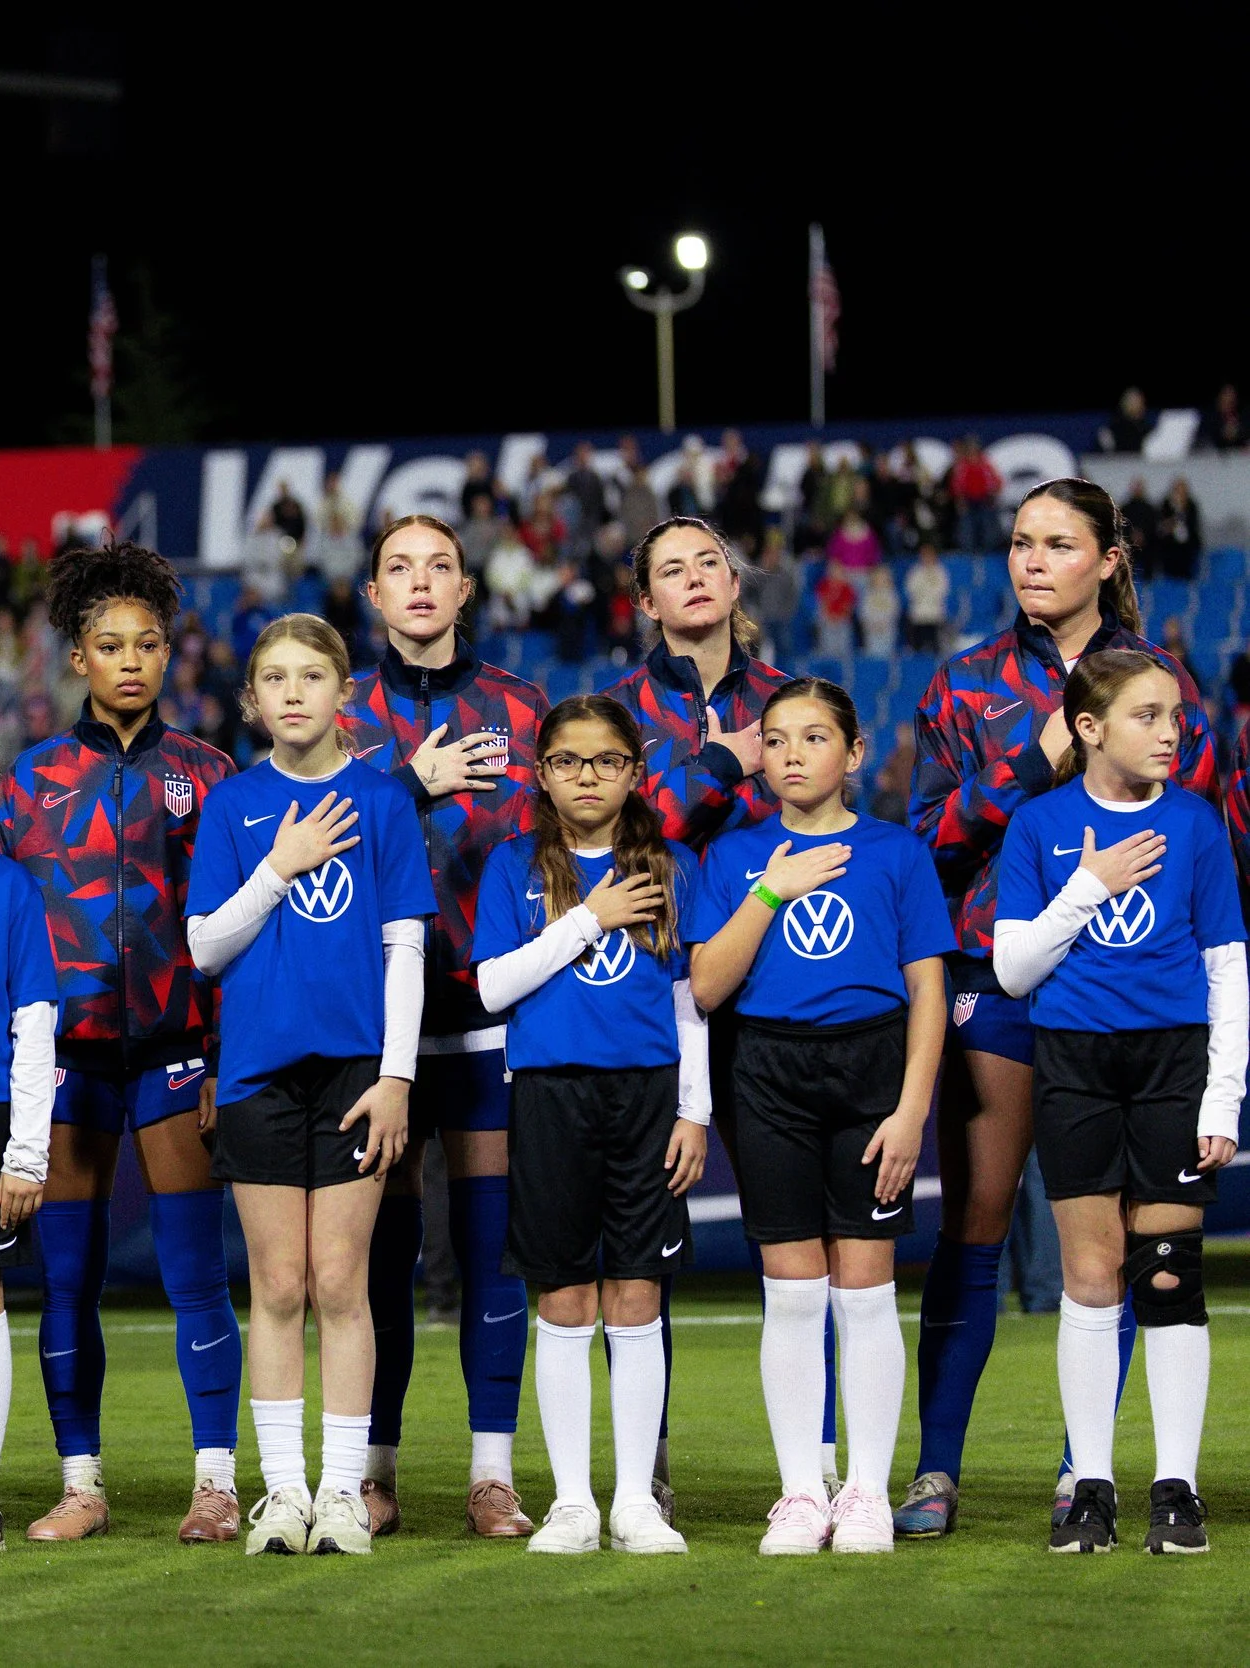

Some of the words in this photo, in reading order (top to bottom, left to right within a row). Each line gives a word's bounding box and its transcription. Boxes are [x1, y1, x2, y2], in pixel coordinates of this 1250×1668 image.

[166, 783, 192, 798] USA
[290, 857, 352, 920] VW
[1090, 886, 1153, 945] VW
[785, 891, 852, 958] VW
